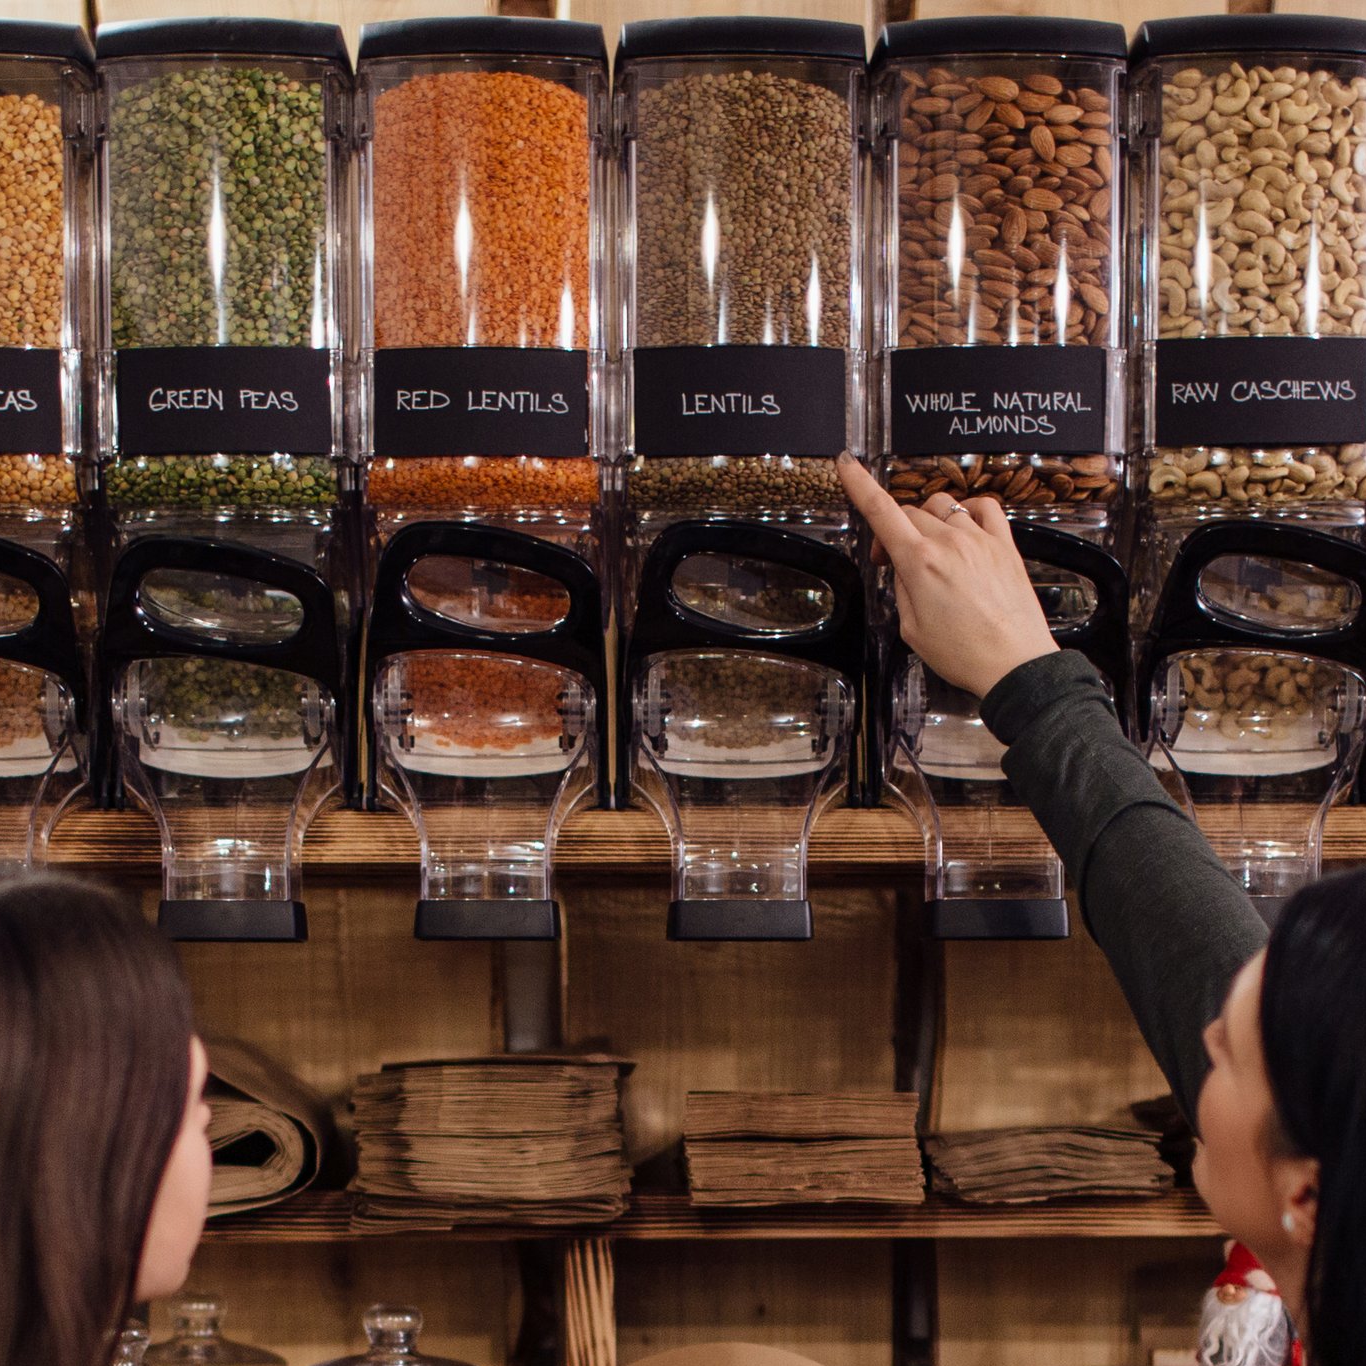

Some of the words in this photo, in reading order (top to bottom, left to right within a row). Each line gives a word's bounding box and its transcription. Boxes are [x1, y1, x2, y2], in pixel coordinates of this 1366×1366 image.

[148, 387, 224, 412] GREEN
[239, 389, 299, 412] PEAS
[396, 389, 451, 411] RED
[467, 390, 569, 415] LENTILS
[905, 392, 982, 413] WHOLE
[993, 391, 1092, 414] NATURAL
[1171, 382, 1219, 404] RAW
[1230, 379, 1357, 402] CASCHEWS
[681, 392, 781, 416] LENTILS
[948, 414, 1057, 436] ALMONDS
